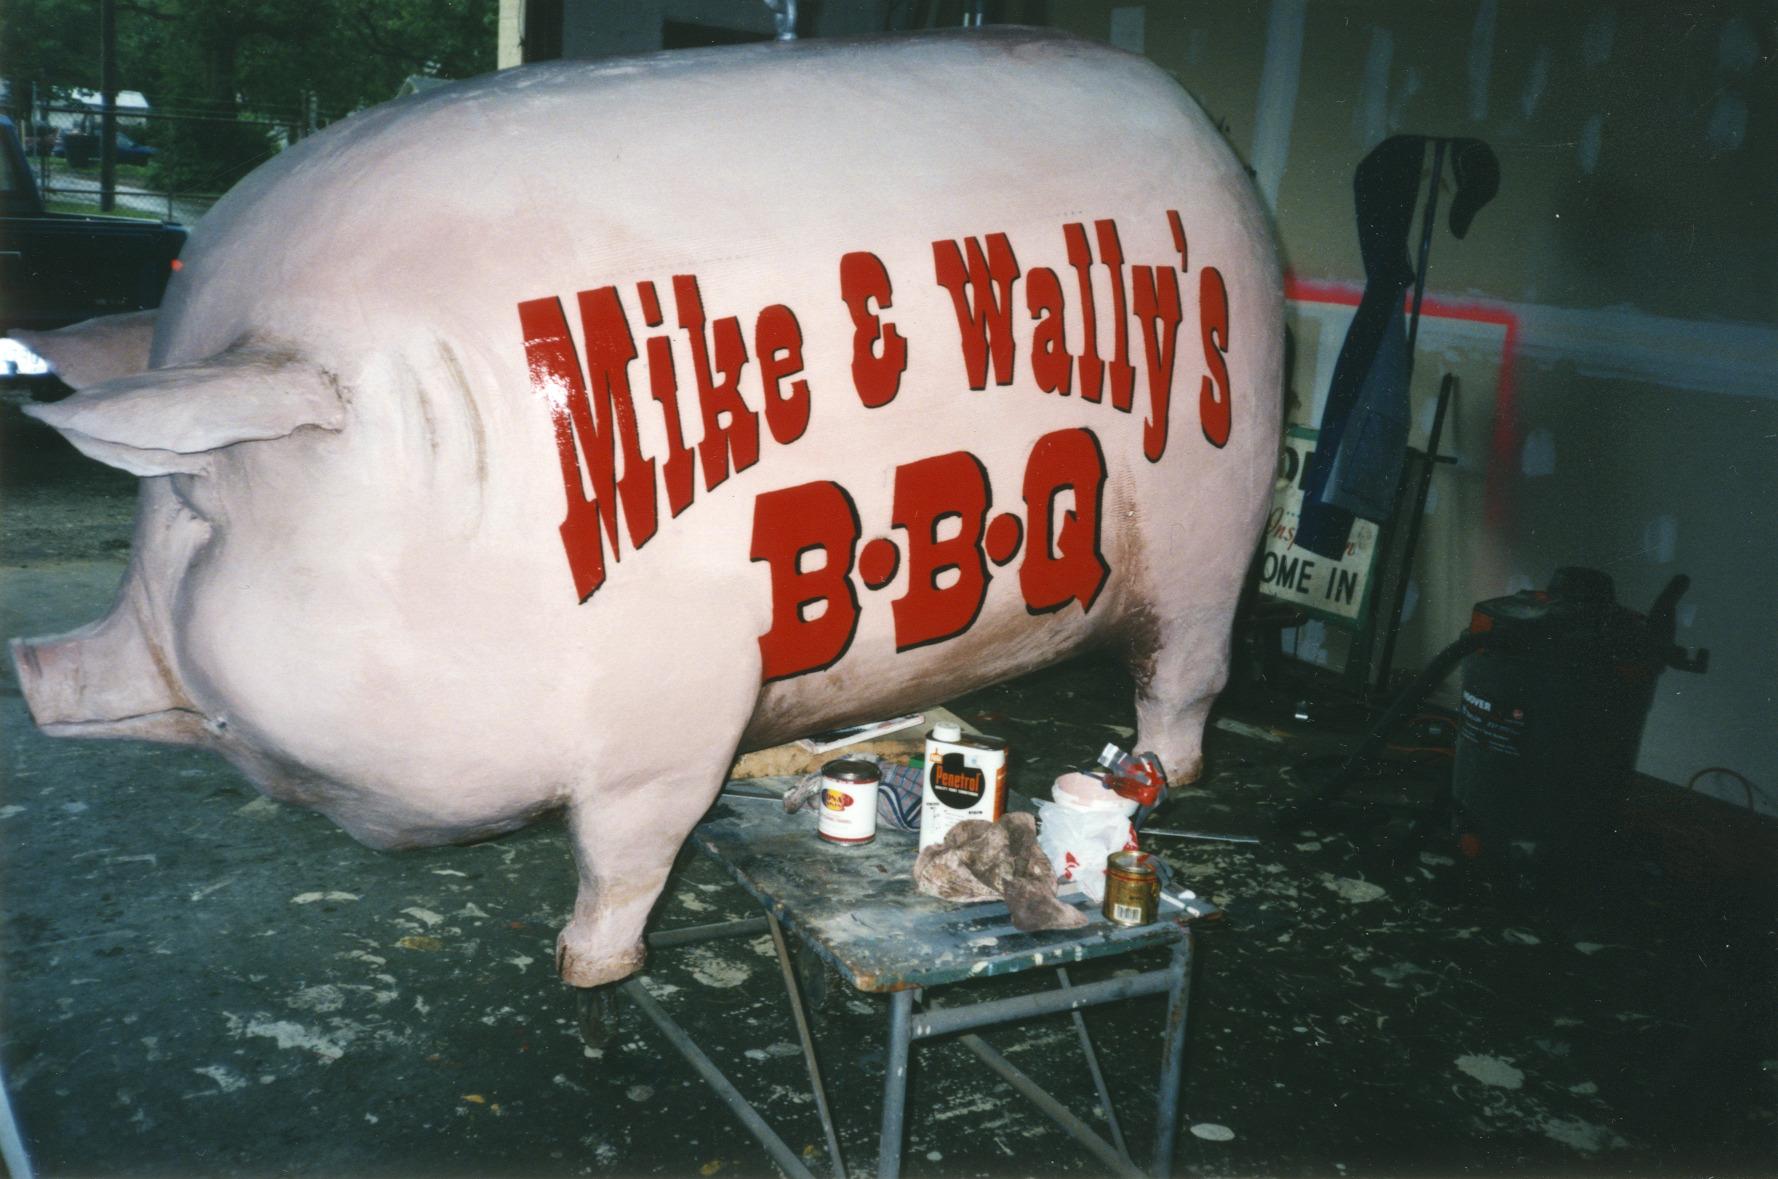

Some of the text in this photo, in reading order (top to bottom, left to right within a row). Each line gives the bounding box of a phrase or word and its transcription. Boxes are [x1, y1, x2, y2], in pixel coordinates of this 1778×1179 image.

[518, 209, 1231, 605] Mike & Wally's
[1261, 552, 1358, 605] OME IN
[935, 764, 980, 792] Penetrol
